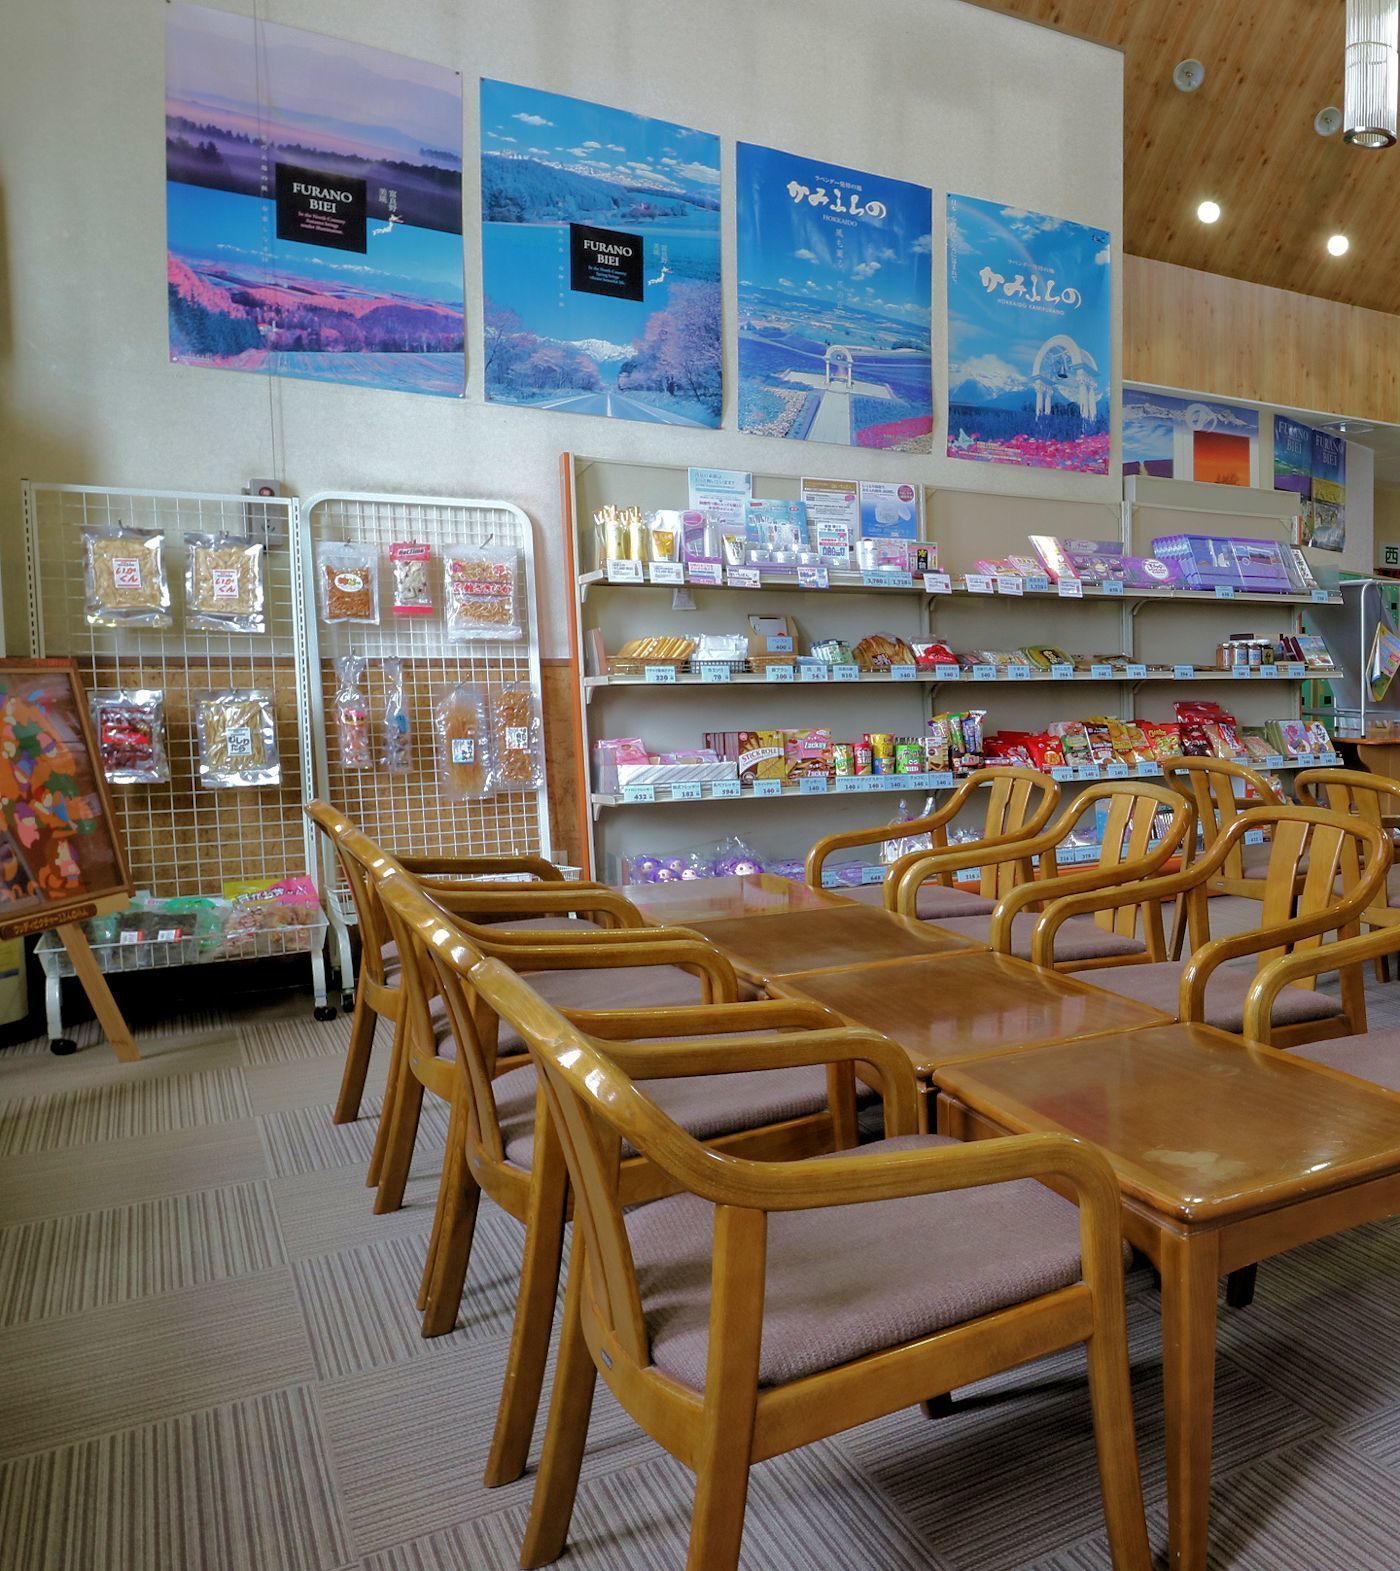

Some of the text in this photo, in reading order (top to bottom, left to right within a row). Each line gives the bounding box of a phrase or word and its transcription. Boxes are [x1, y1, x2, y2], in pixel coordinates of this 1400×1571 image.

[292, 182, 352, 203] FURANO
[787, 180, 887, 219] かみふらの
[309, 199, 337, 213] BIEI
[822, 214, 858, 227] HOKKAIDO
[583, 239, 632, 257] FURANO
[597, 254, 619, 266] BIEI
[979, 266, 1082, 310] かみふらの
[1278, 421, 1309, 441] FURANO
[1286, 440, 1302, 454] BIEI
[1315, 434, 1344, 453] FURANO
[1322, 452, 1337, 466] BIEI
[741, 748, 778, 763] STICK ROLL
